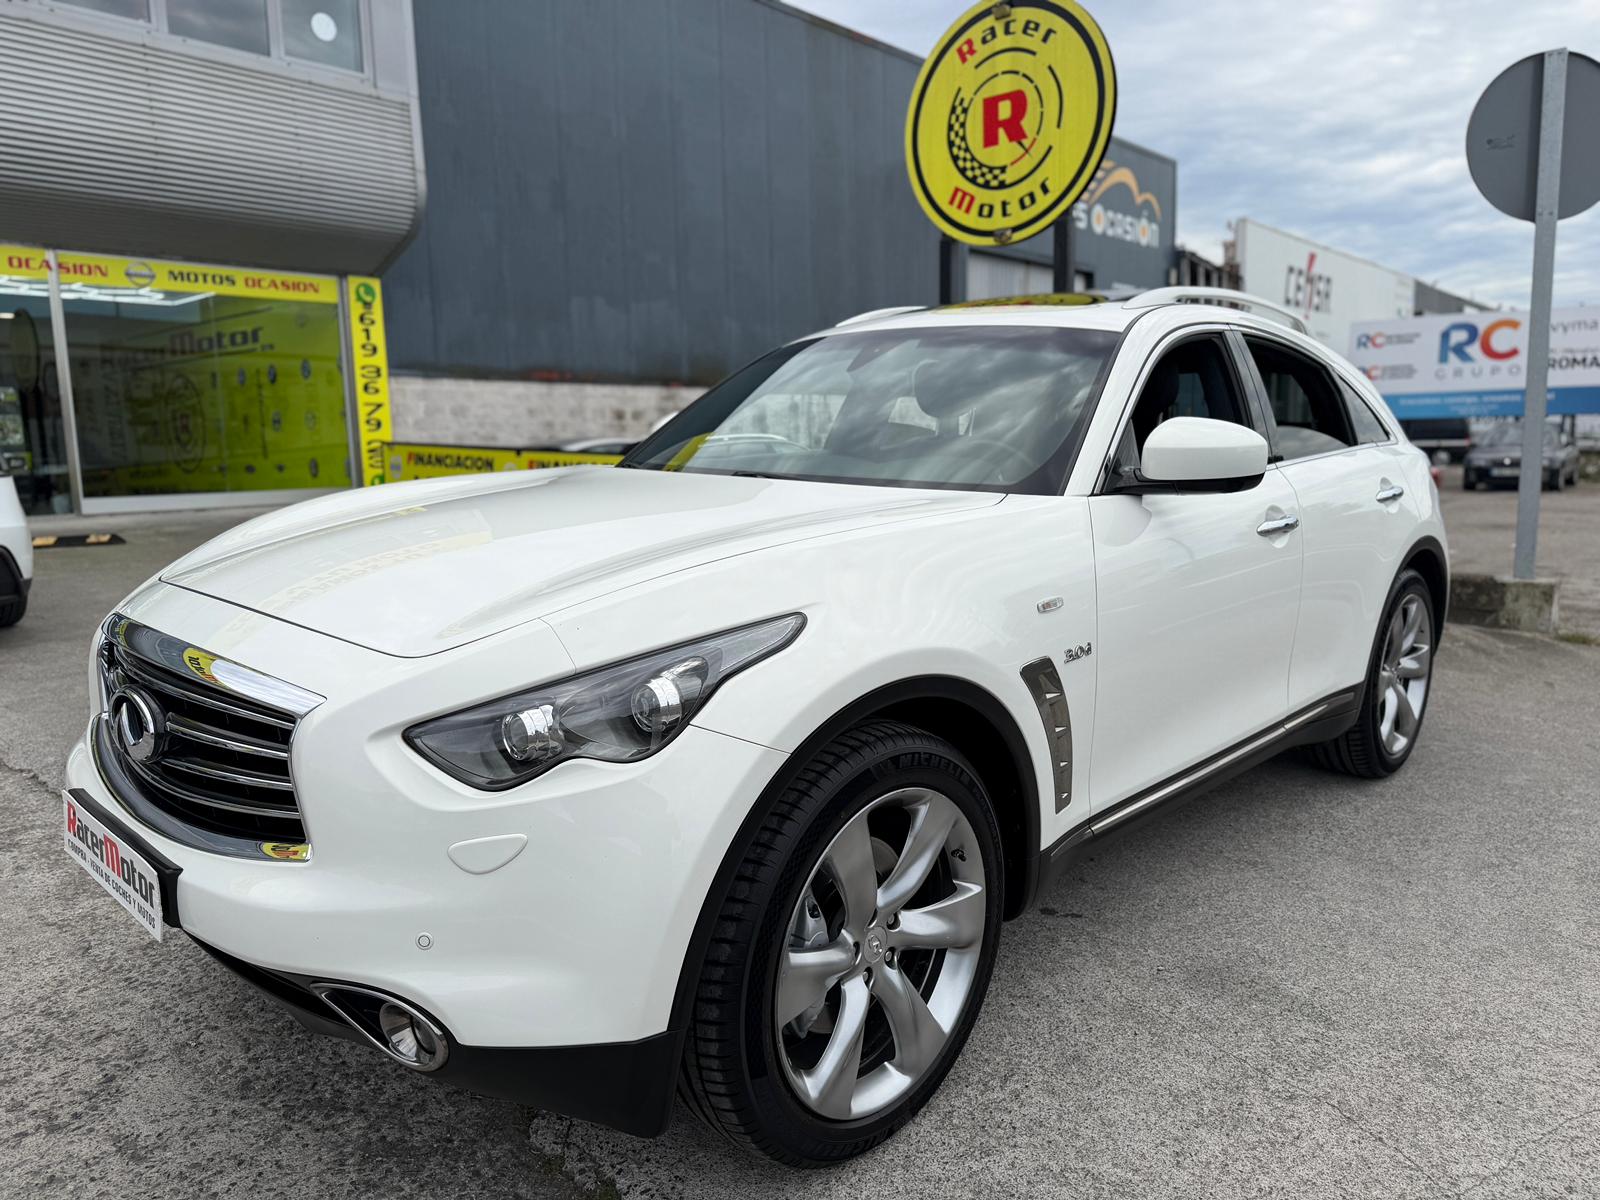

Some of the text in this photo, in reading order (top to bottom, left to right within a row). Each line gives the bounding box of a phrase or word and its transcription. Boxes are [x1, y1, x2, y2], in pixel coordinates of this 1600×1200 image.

[956, 19, 1057, 64] Racer
[983, 89, 1028, 149] R
[948, 177, 1051, 219] Motor
[7, 255, 321, 294] OCASION MOTOS OCASION
[1356, 330, 1386, 350] RC
[1438, 318, 1522, 363] RC
[1434, 363, 1522, 381] GRUPO
[406, 450, 496, 472] FINANCIACION
[89, 857, 105, 880] VENTA
[104, 871, 112, 887] DE
[111, 879, 132, 906] COCHES
